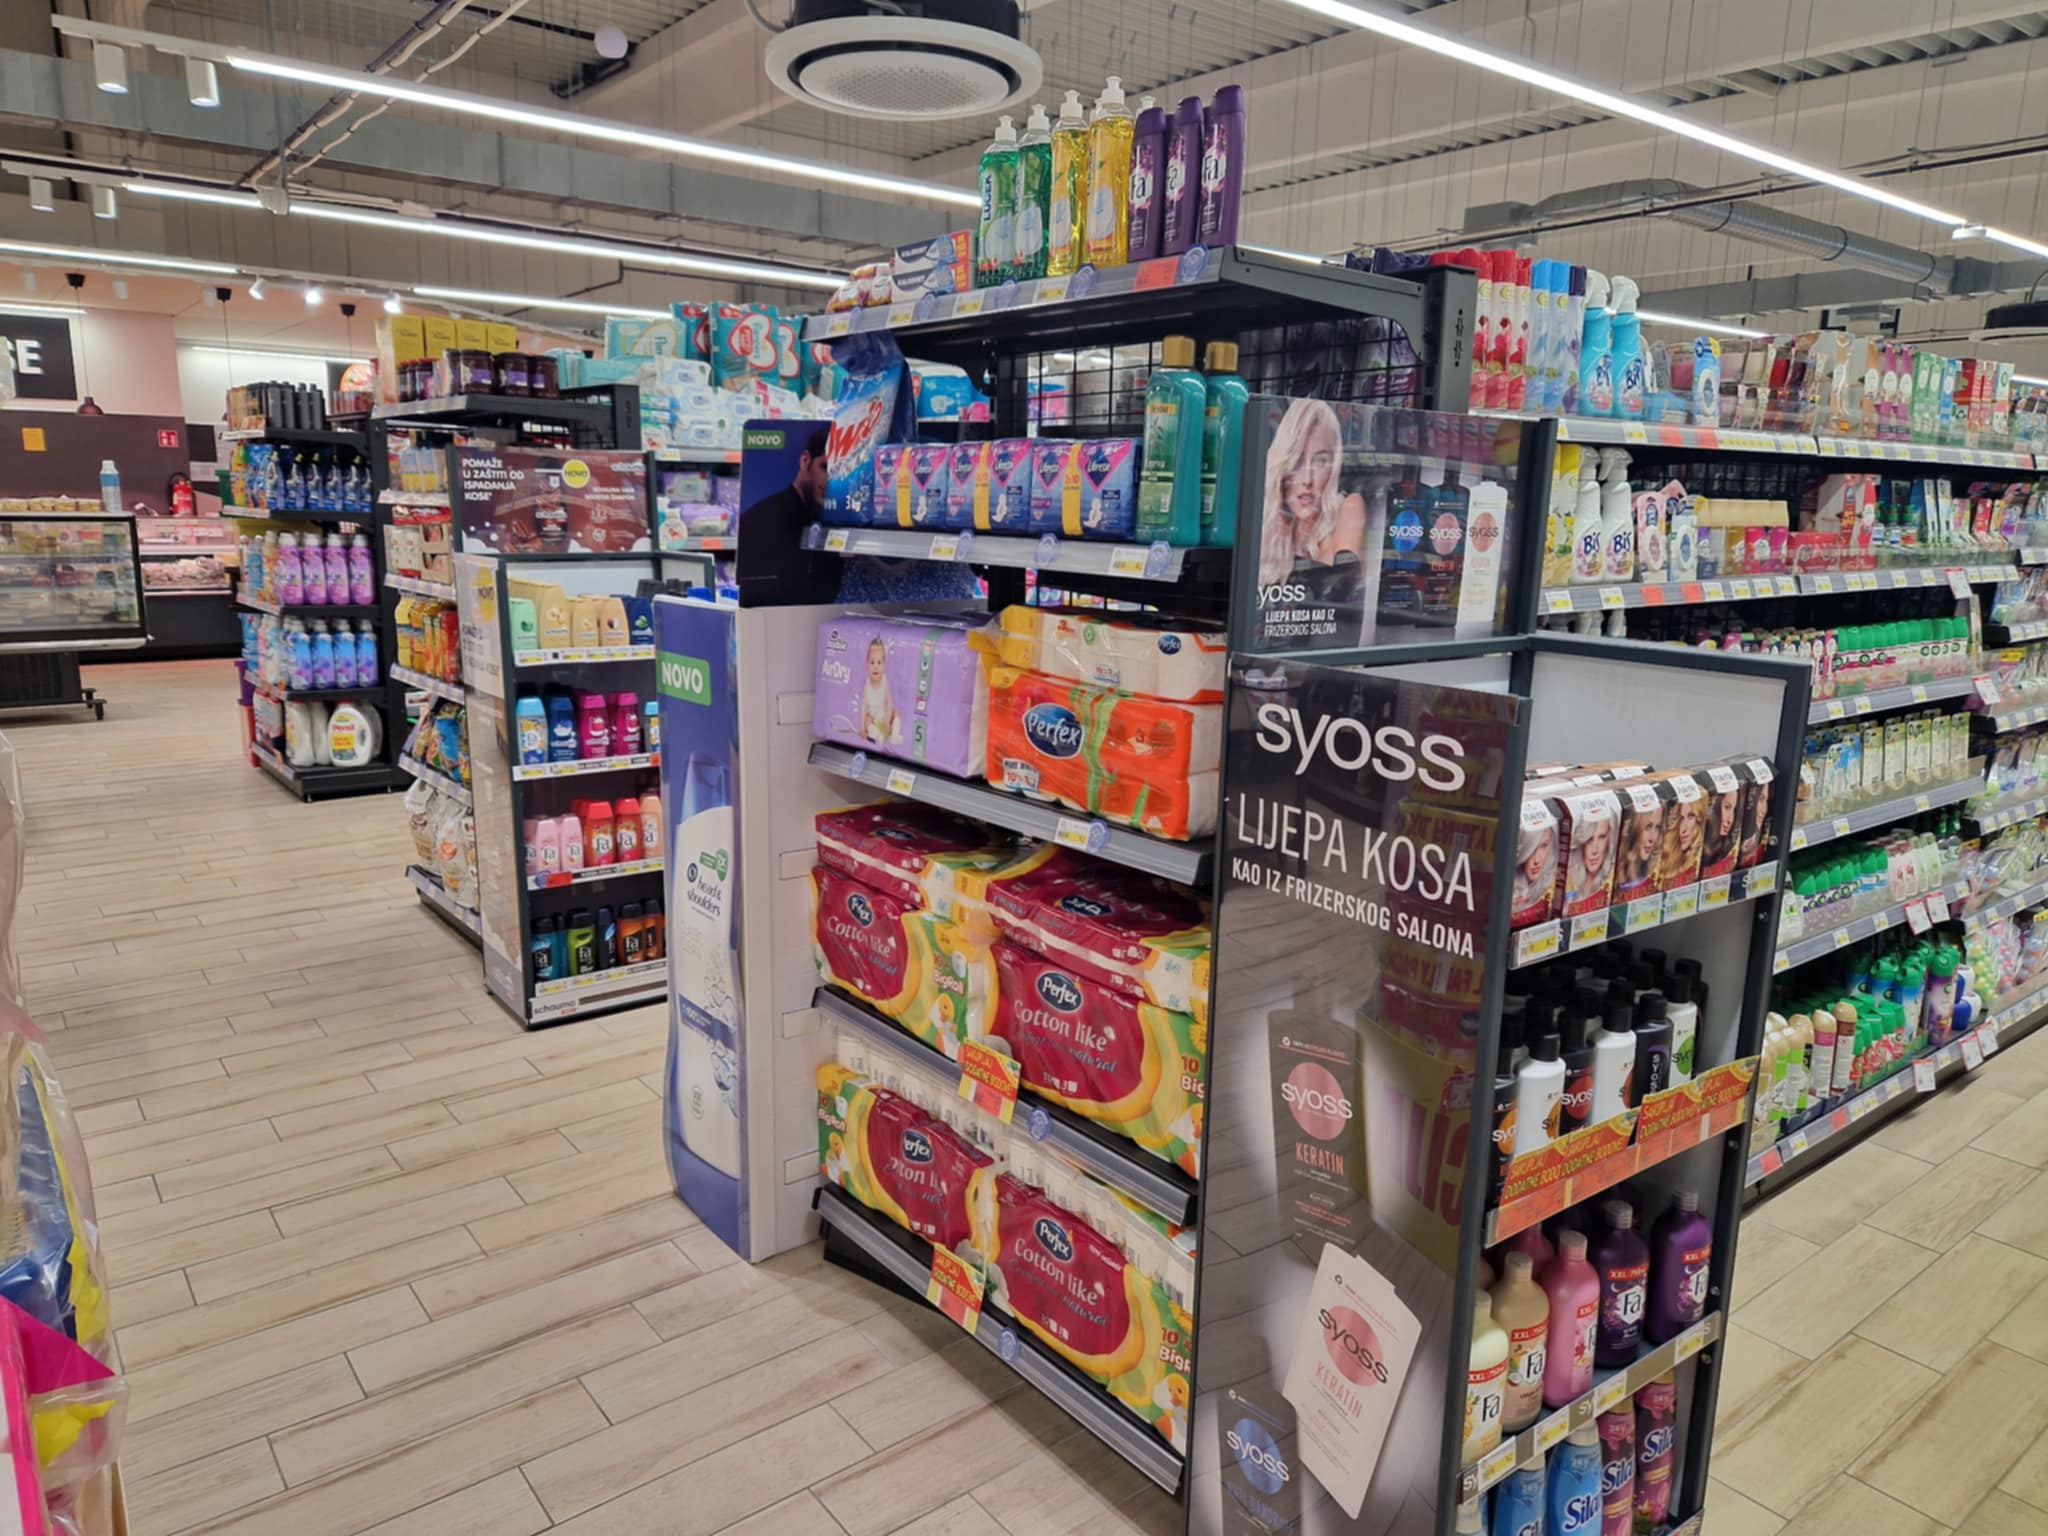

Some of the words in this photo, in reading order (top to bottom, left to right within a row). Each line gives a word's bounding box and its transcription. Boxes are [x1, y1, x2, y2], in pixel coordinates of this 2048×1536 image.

[747, 434, 782, 446] NOVO
[462, 458, 503, 469] POMAŽE
[509, 471, 524, 480] OD
[564, 469, 588, 478] NOVO
[464, 480, 516, 491] ISPADANJA
[1258, 583, 1306, 609] yoss
[1265, 610, 1290, 623] LIJEPA
[1291, 610, 1311, 622] KOSA
[1312, 609, 1326, 621] KAO
[1327, 608, 1335, 620] IZ
[1264, 623, 1309, 637] FRIZERSKOG
[1310, 622, 1337, 635] SALONA
[1159, 640, 1181, 652] Perfex
[662, 661, 703, 694] NOVO
[915, 726, 922, 742] 5
[1026, 711, 1081, 746] Perfex
[1256, 702, 1465, 791] syoss
[596, 837, 610, 854] Fa
[619, 832, 632, 848] Fa
[1238, 792, 1348, 874] LIJEPA
[1361, 826, 1475, 912] KOSA
[1232, 857, 1260, 885] KAO
[1266, 869, 1281, 893] IZ
[1285, 876, 1391, 931] FRIZERSKOG
[1396, 911, 1474, 959] SALONA
[1042, 977, 1079, 1006] Perfex
[534, 1000, 576, 1015] schauma
[1014, 1000, 1070, 1042] Cotton
[1075, 1022, 1107, 1052] like
[1182, 1055, 1199, 1074] 10
[1281, 1082, 1353, 1119] syoss
[903, 1137, 930, 1158] erfex
[1295, 1141, 1345, 1177] KERATIN
[1039, 1223, 1071, 1258] Perfex
[1014, 1237, 1065, 1286] Cotton
[1068, 1272, 1099, 1306] like
[1623, 1291, 1642, 1316] Fa
[1162, 1327, 1178, 1345] 10
[1318, 1308, 1390, 1385] syoss
[1513, 1331, 1530, 1339] XXL
[1526, 1350, 1543, 1379] Fa
[1315, 1361, 1363, 1420] KERATIN
[1482, 1393, 1501, 1422] Fa
[1226, 1430, 1290, 1482] syoss
